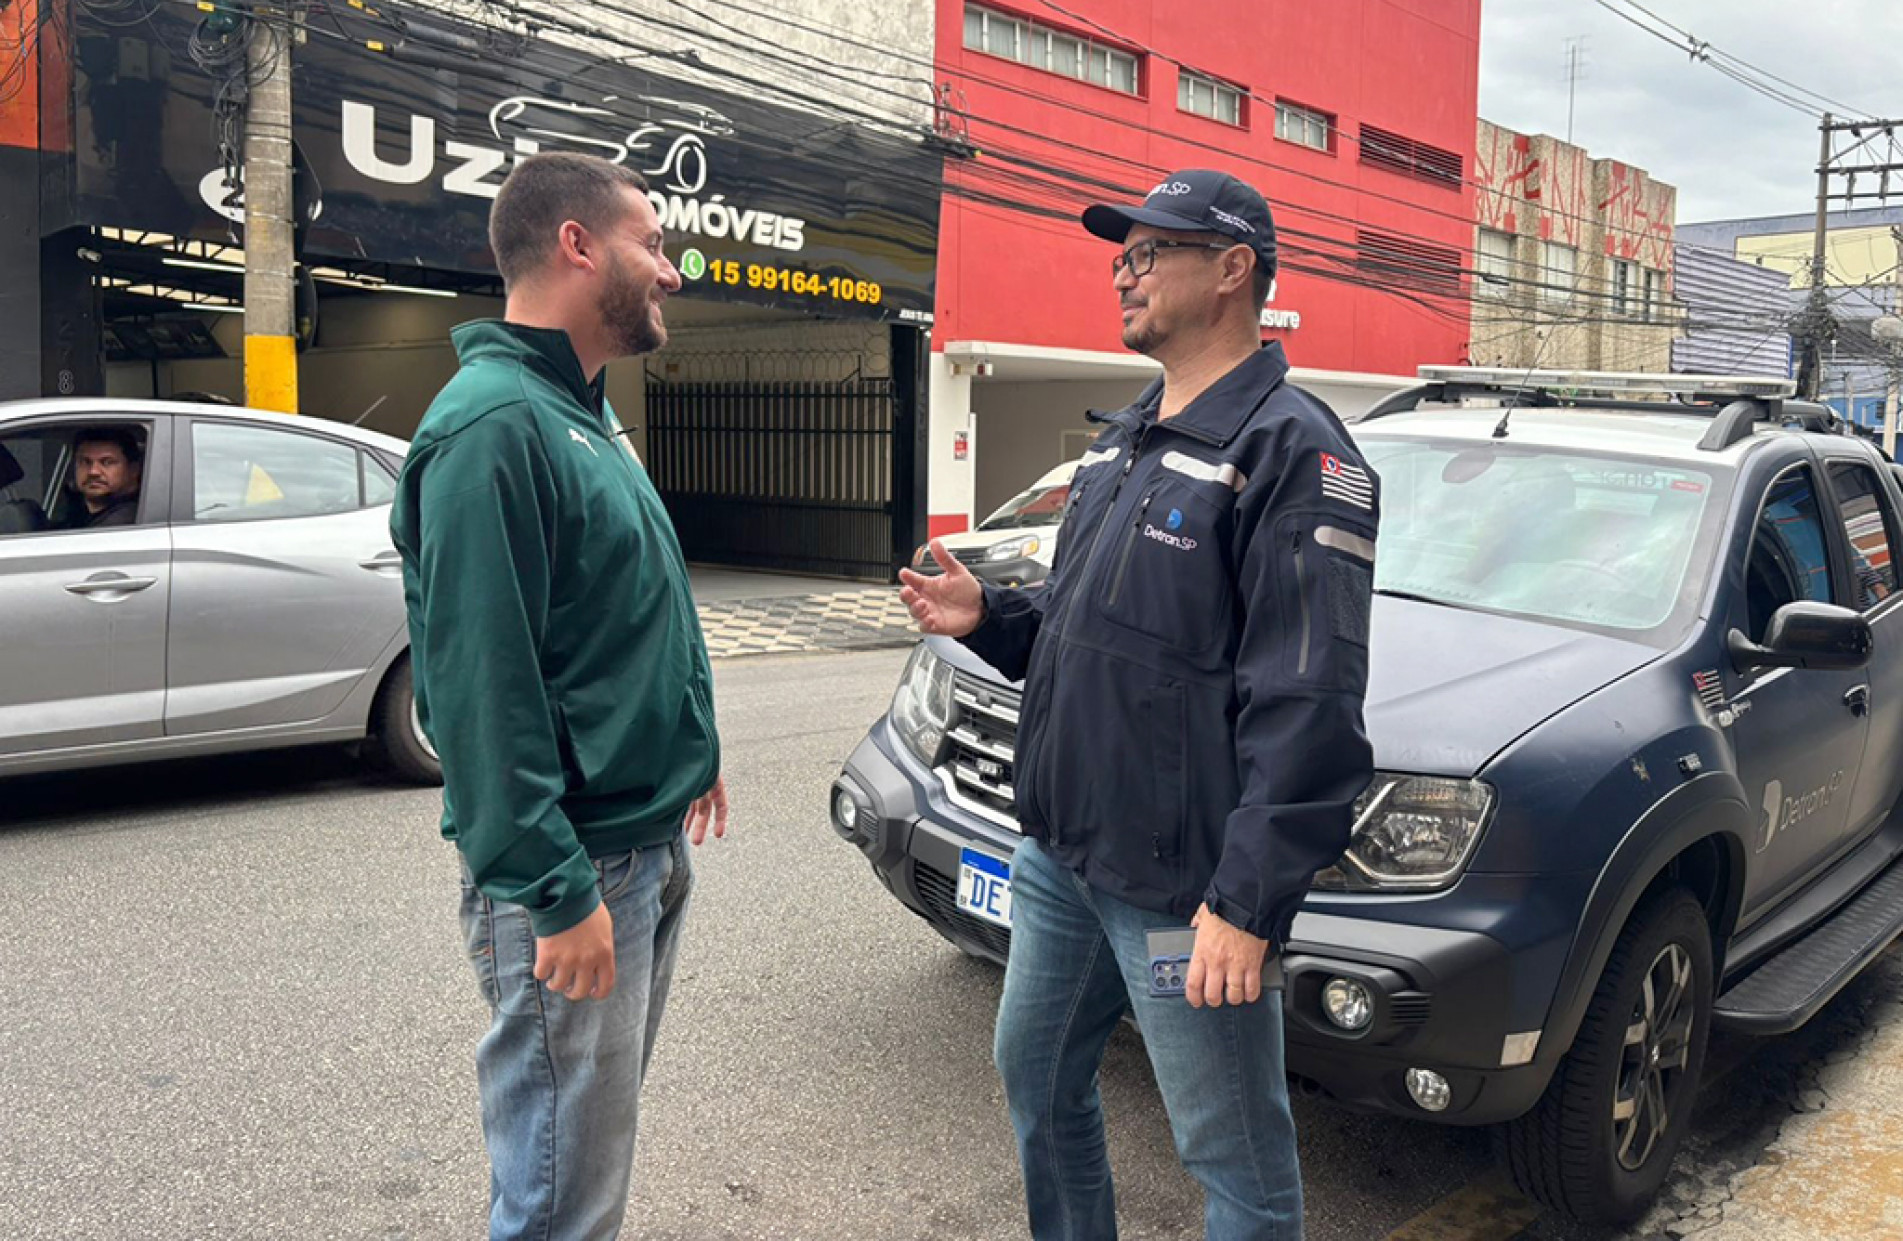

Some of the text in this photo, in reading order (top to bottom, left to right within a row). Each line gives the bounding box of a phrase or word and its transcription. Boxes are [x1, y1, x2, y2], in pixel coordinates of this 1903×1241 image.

[648, 190, 805, 251] OMÓVEIS
[709, 259, 882, 304] 15 99164-1069
[969, 872, 1013, 921] DE
